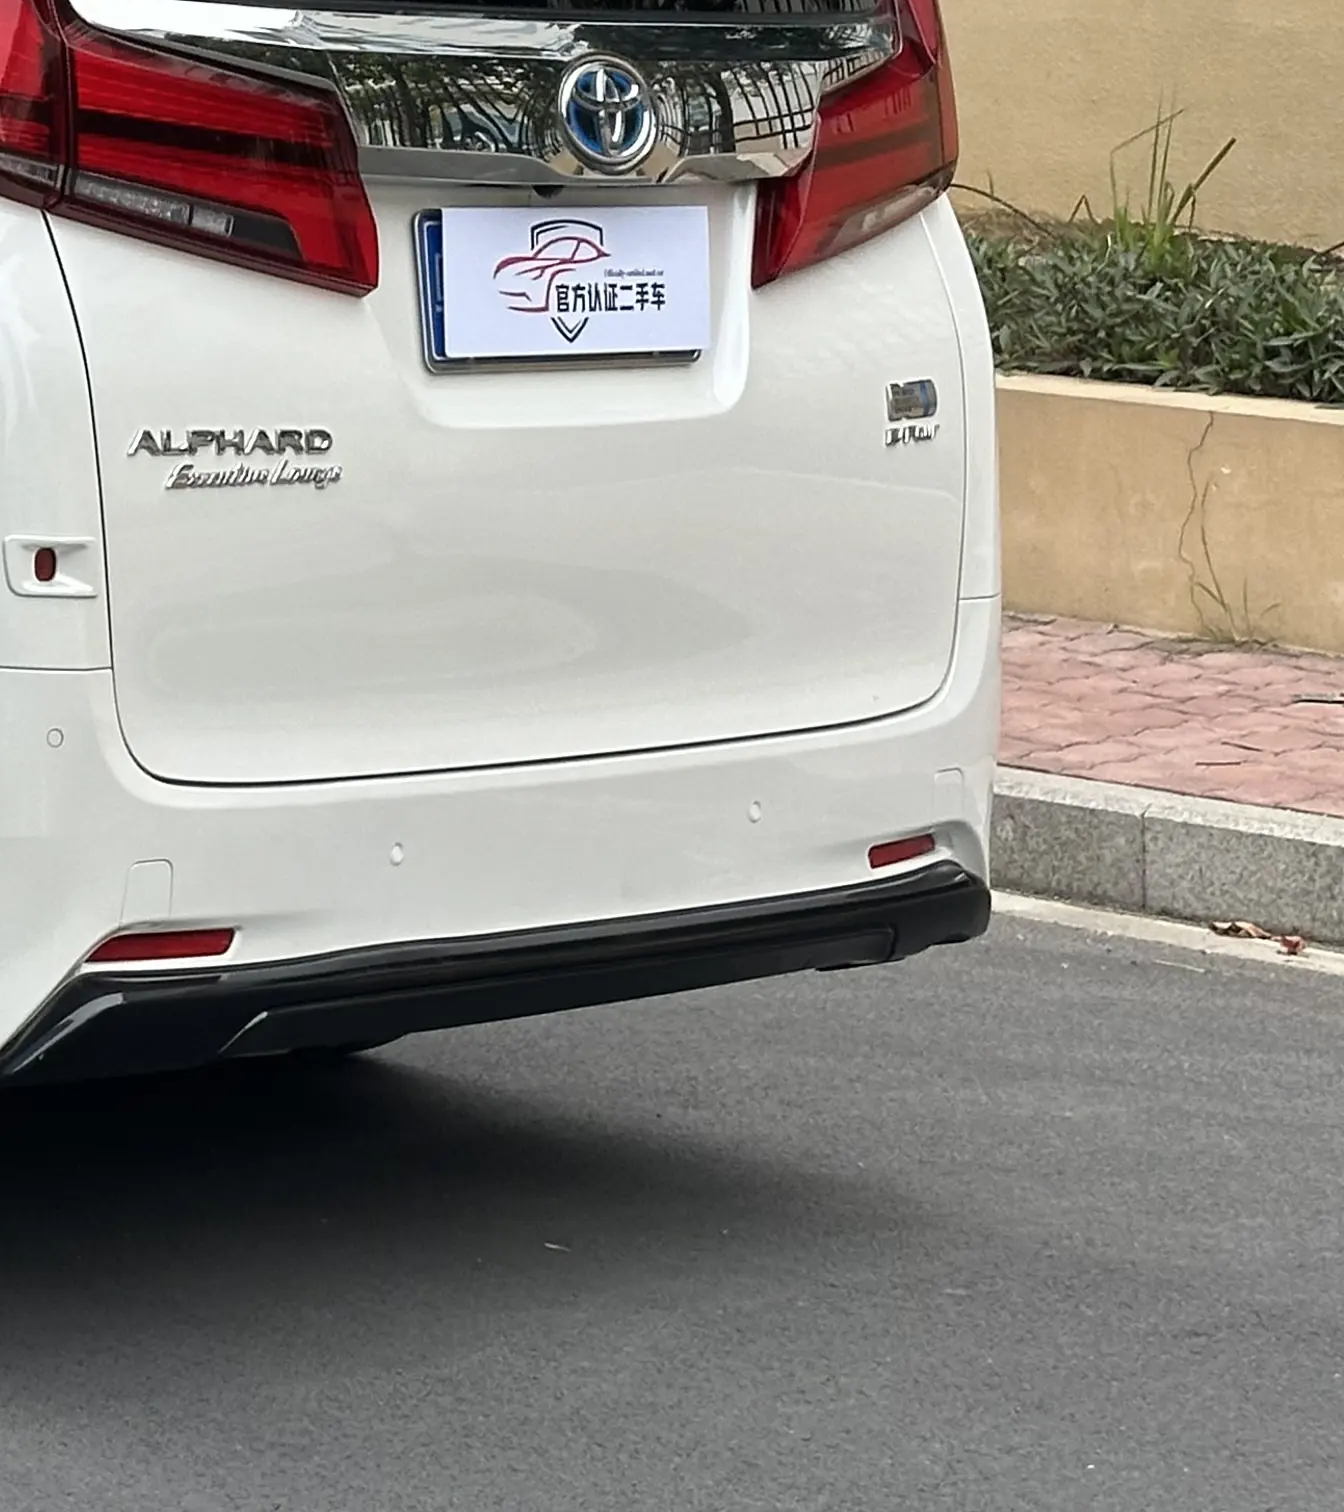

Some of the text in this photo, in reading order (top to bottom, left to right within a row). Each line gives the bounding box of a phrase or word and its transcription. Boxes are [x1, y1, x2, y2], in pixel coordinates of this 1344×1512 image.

[555, 282, 666, 313] 官方认证二手车
[126, 427, 334, 456] ALPHARD
[269, 457, 343, 490] Lounge
